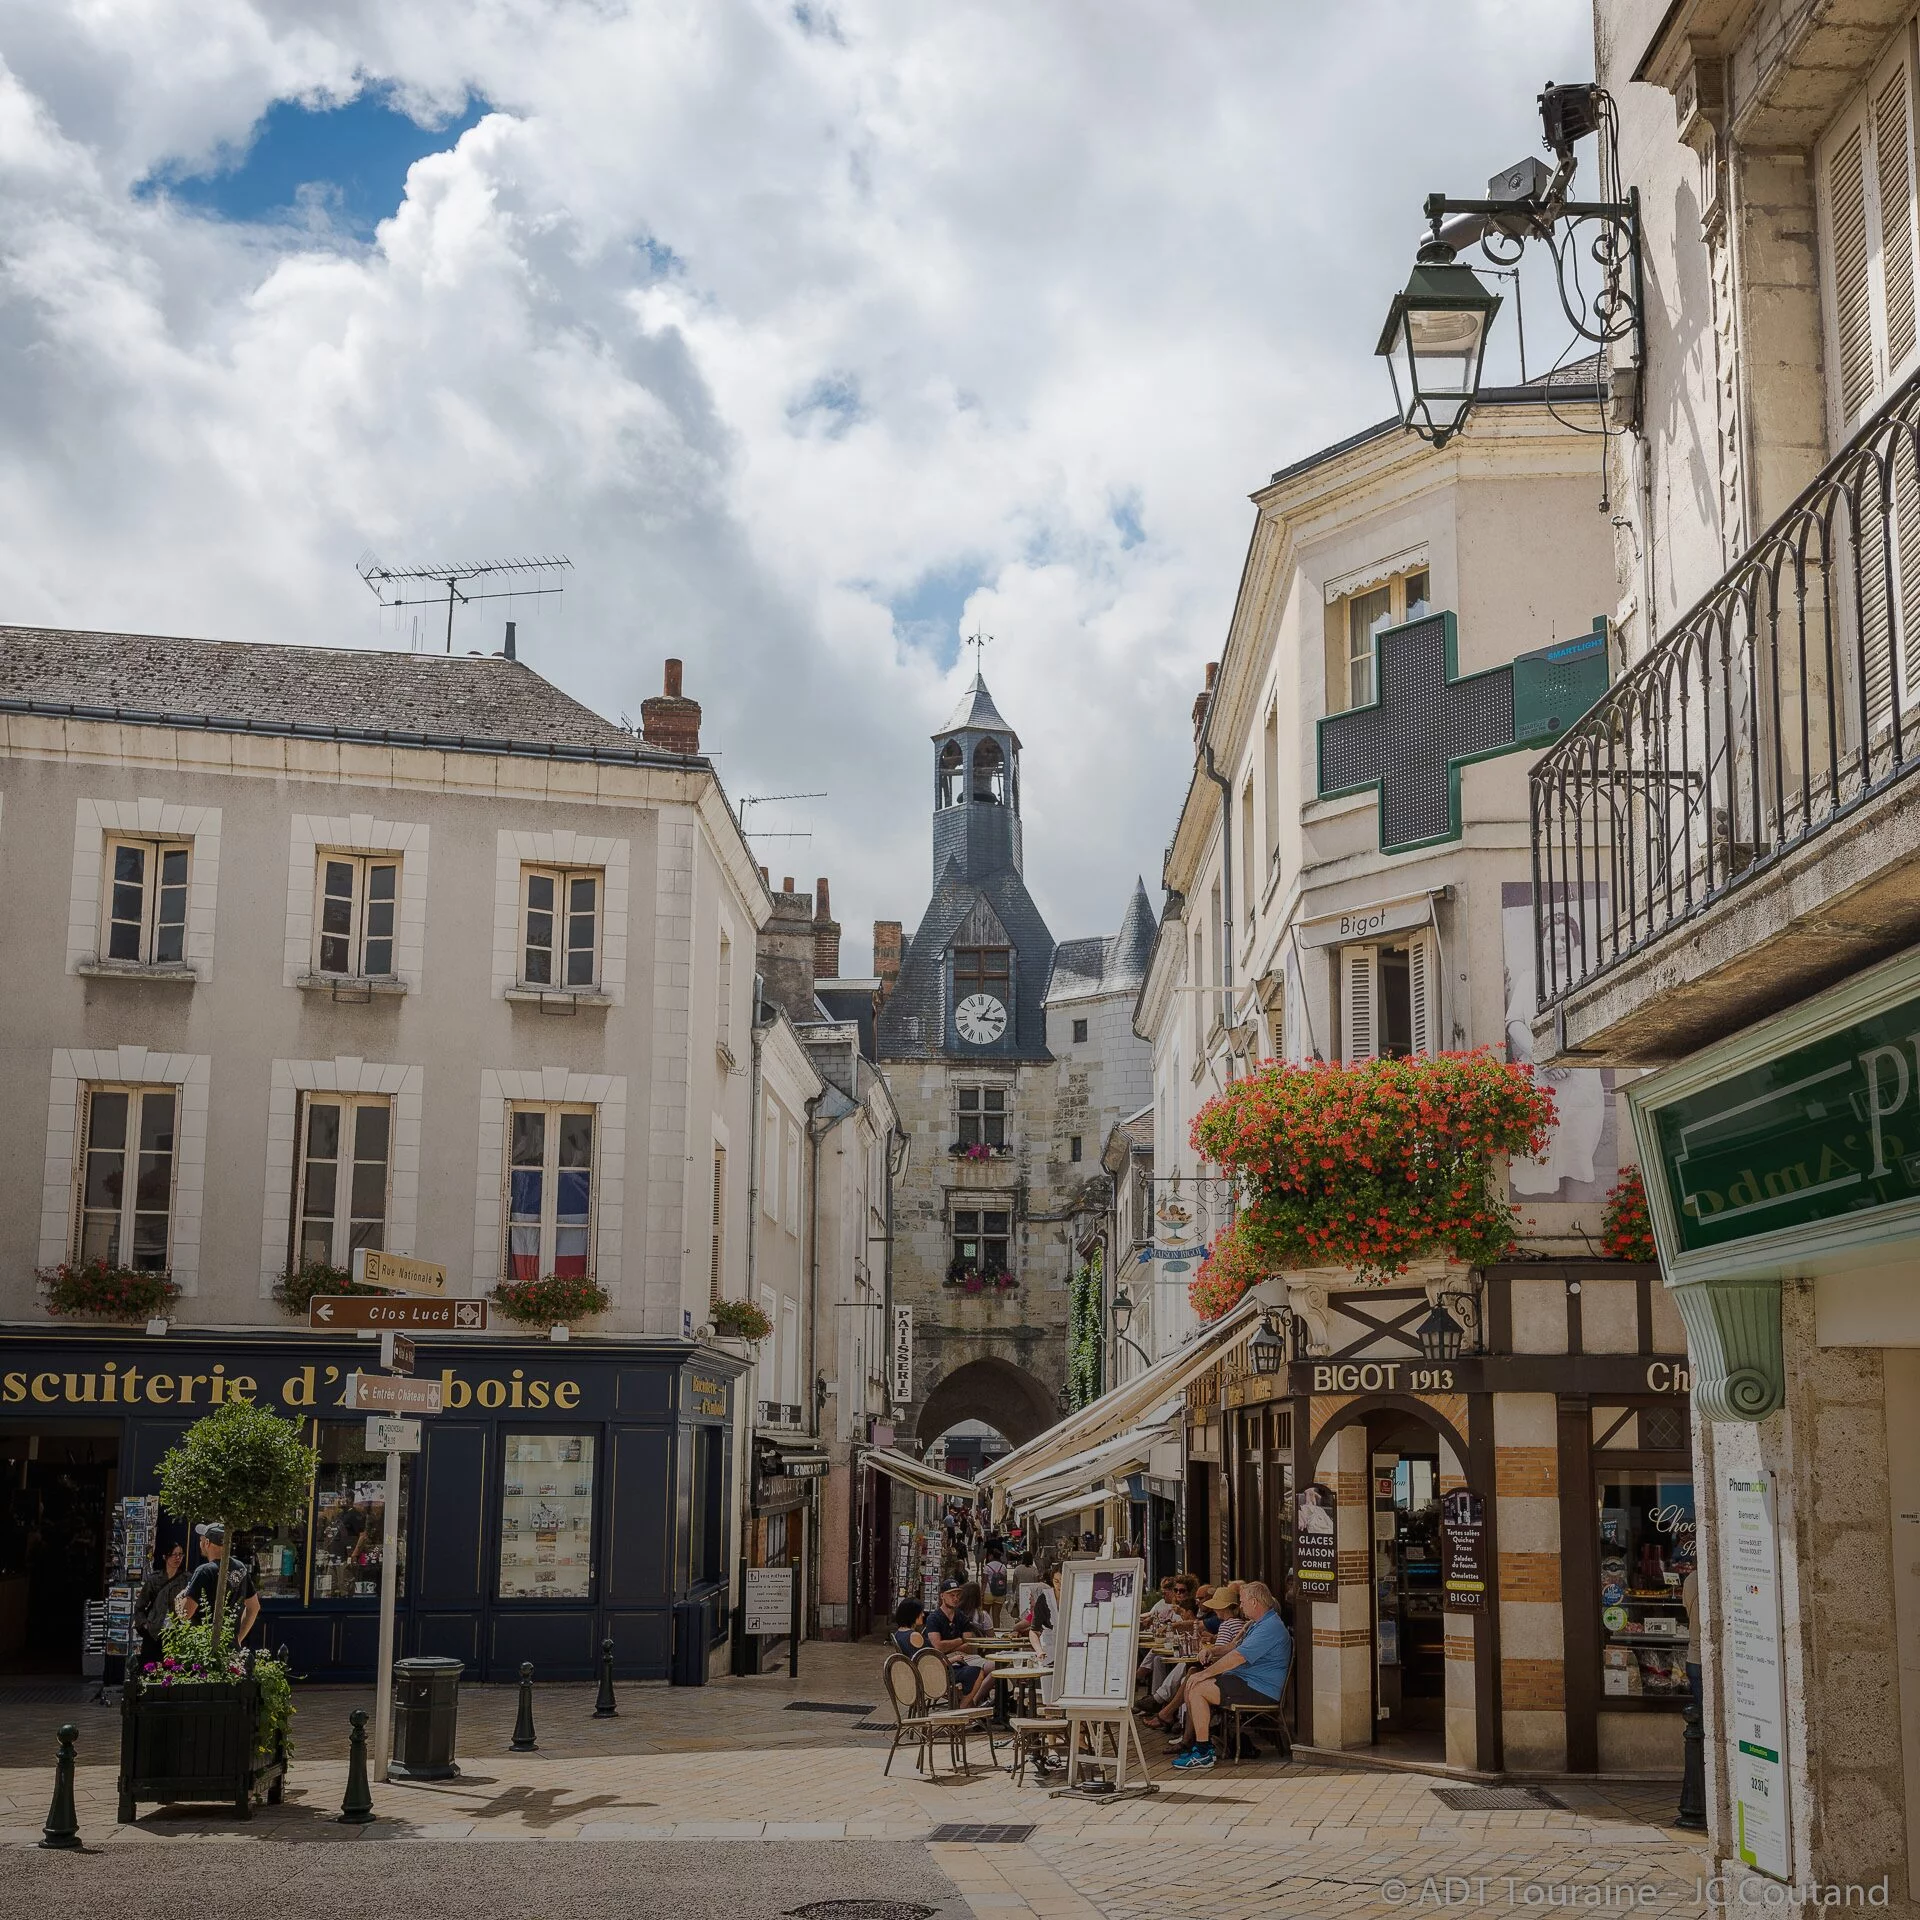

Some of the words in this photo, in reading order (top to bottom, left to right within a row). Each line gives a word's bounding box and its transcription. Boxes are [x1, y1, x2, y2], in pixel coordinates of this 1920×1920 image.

[1547, 637, 1605, 661] SMARTLIGHT
[1340, 908, 1386, 936] Bigot
[1150, 1248, 1178, 1259] MAISON
[381, 1263, 396, 1277] Rue
[398, 1267, 433, 1284] Nationale
[369, 1306, 406, 1320] Clos
[412, 1306, 450, 1321] Lucé
[897, 1310, 910, 1397] PATISSERIE
[1314, 1363, 1400, 1391] BIGOT
[1409, 1368, 1455, 1390] 1913
[372, 1386, 395, 1400] Entrée
[397, 1387, 426, 1403] Château
[1729, 1477, 1768, 1493] Pharmactiv
[1447, 1528, 1463, 1536] Tartes
[1464, 1529, 1480, 1537] salées
[1299, 1535, 1334, 1546] GLACES
[1452, 1535, 1475, 1544] Quiches
[1298, 1547, 1335, 1558] MAISON
[1455, 1544, 1472, 1552] Pizzas
[1453, 1554, 1474, 1562] Salades
[1302, 1560, 1332, 1569] CORNET
[1459, 1561, 1478, 1569] fournil
[1451, 1571, 1479, 1580] Omelettes
[1302, 1581, 1331, 1592] BIGOT
[1450, 1592, 1481, 1603] BIGOT
